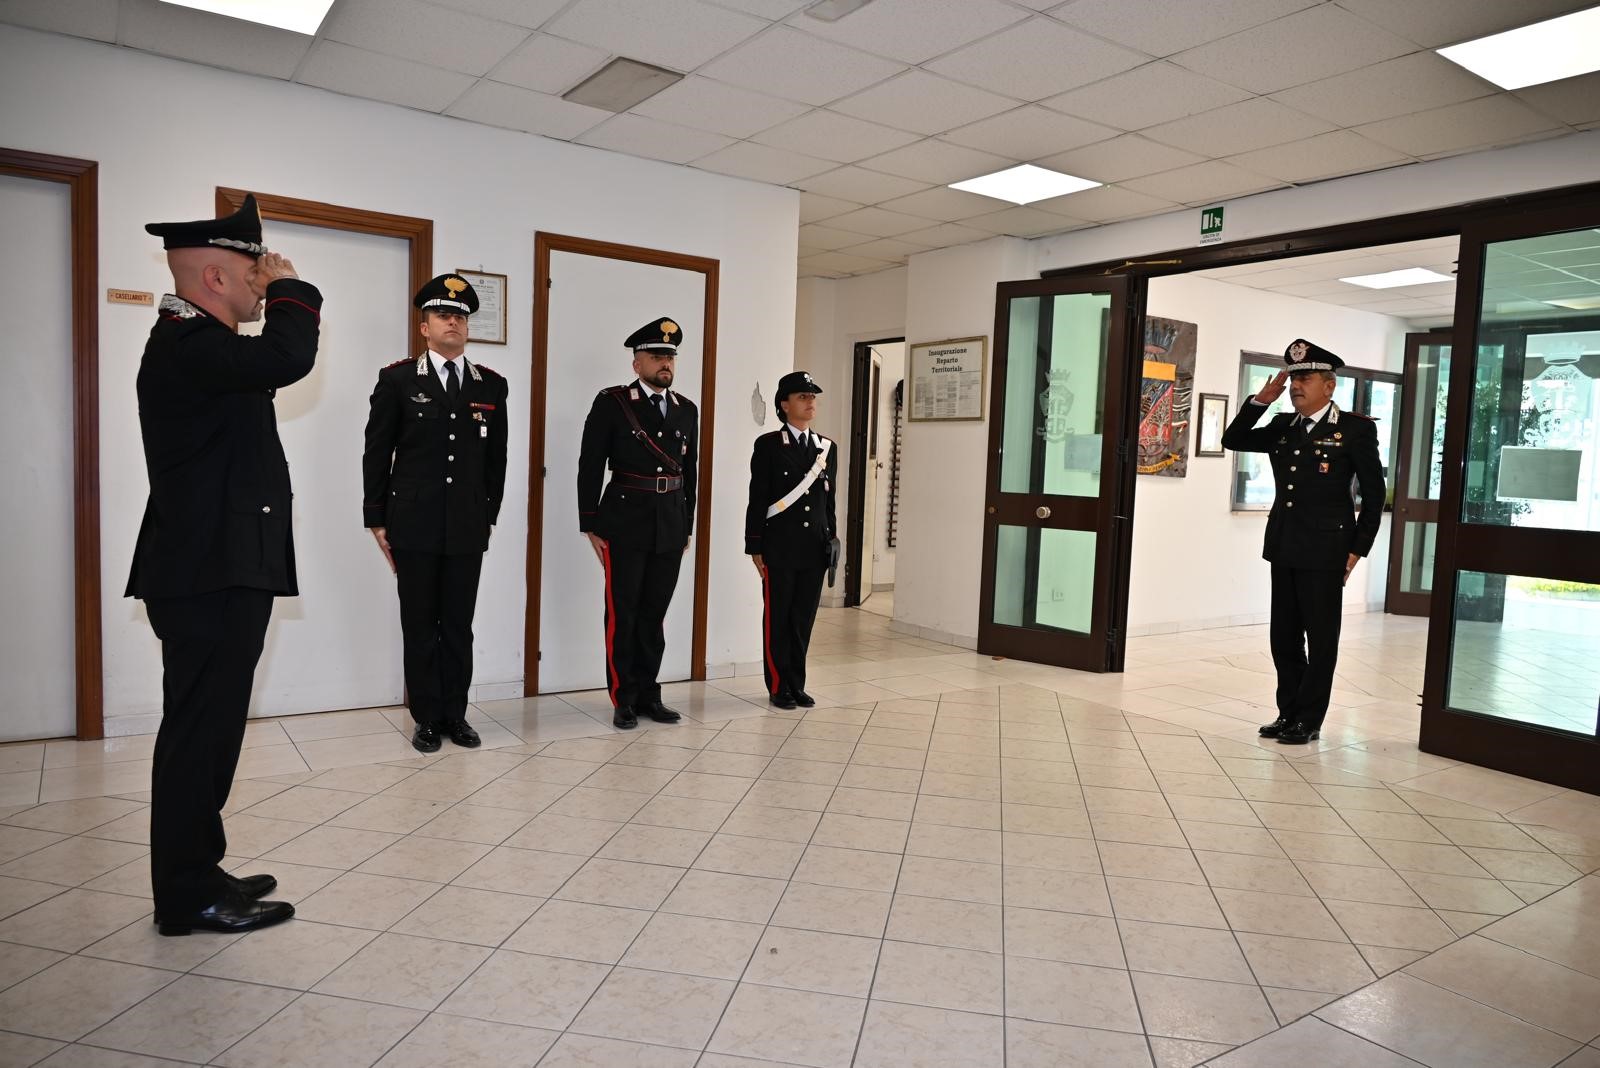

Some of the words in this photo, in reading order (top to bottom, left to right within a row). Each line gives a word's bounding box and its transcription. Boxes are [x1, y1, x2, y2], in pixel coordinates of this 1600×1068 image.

[928, 347, 968, 357] Inaugurazione
[936, 357, 959, 366] Reparto
[931, 365, 963, 374] Territoriale
